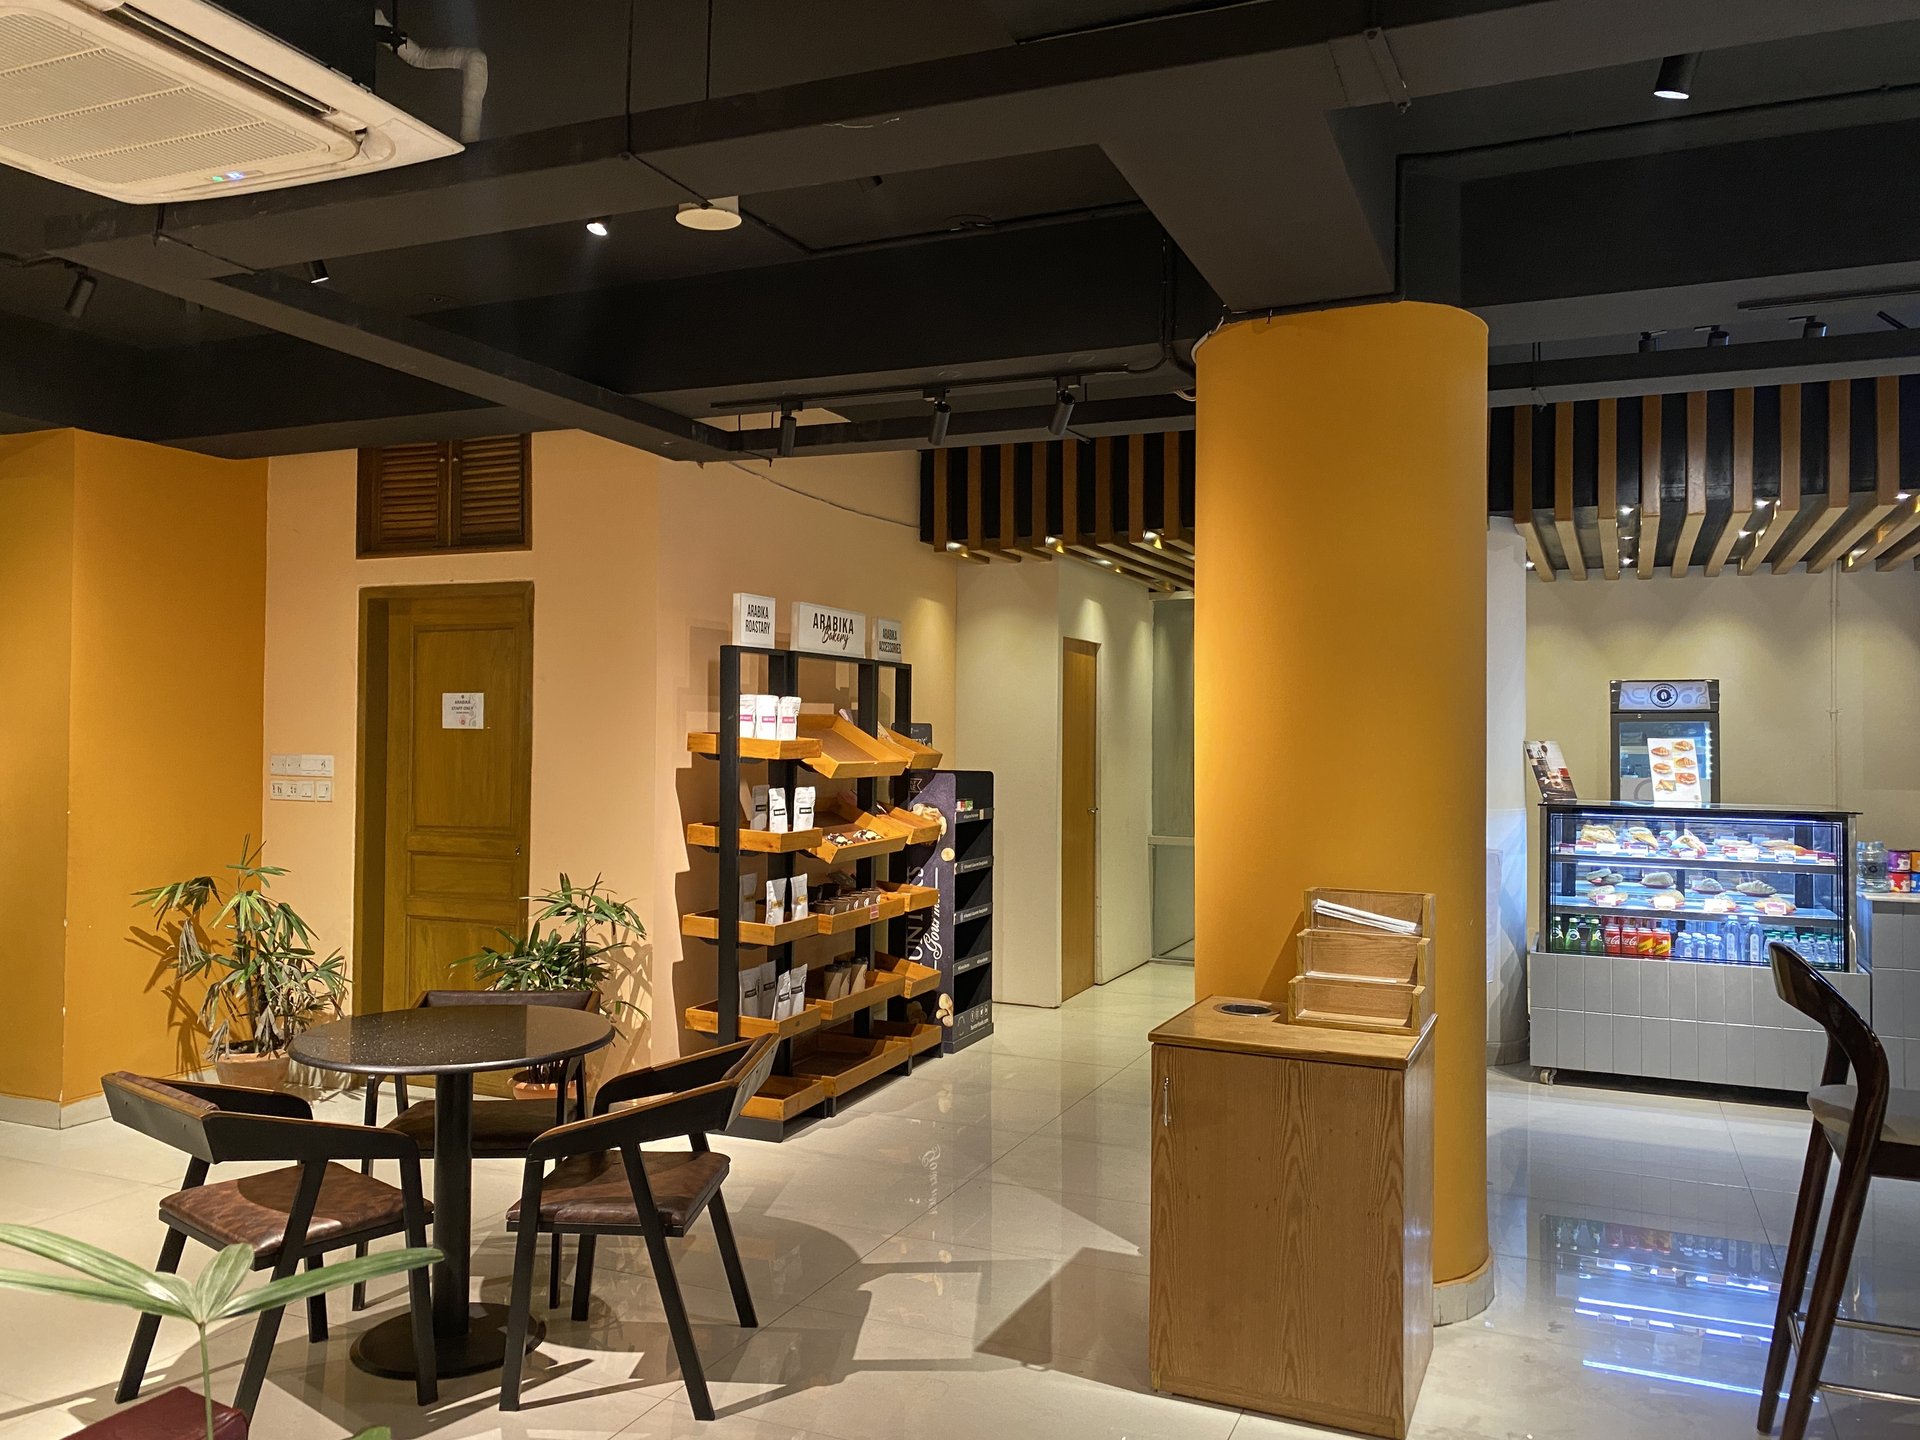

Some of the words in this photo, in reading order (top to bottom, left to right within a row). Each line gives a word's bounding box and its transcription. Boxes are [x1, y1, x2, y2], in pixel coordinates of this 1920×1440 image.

[747, 604, 769, 619] ARABIKA
[745, 620, 770, 634] ROASTARY
[813, 613, 853, 634] ARABIKA
[822, 625, 850, 650] Bakery
[883, 628, 897, 640] ARABIKA
